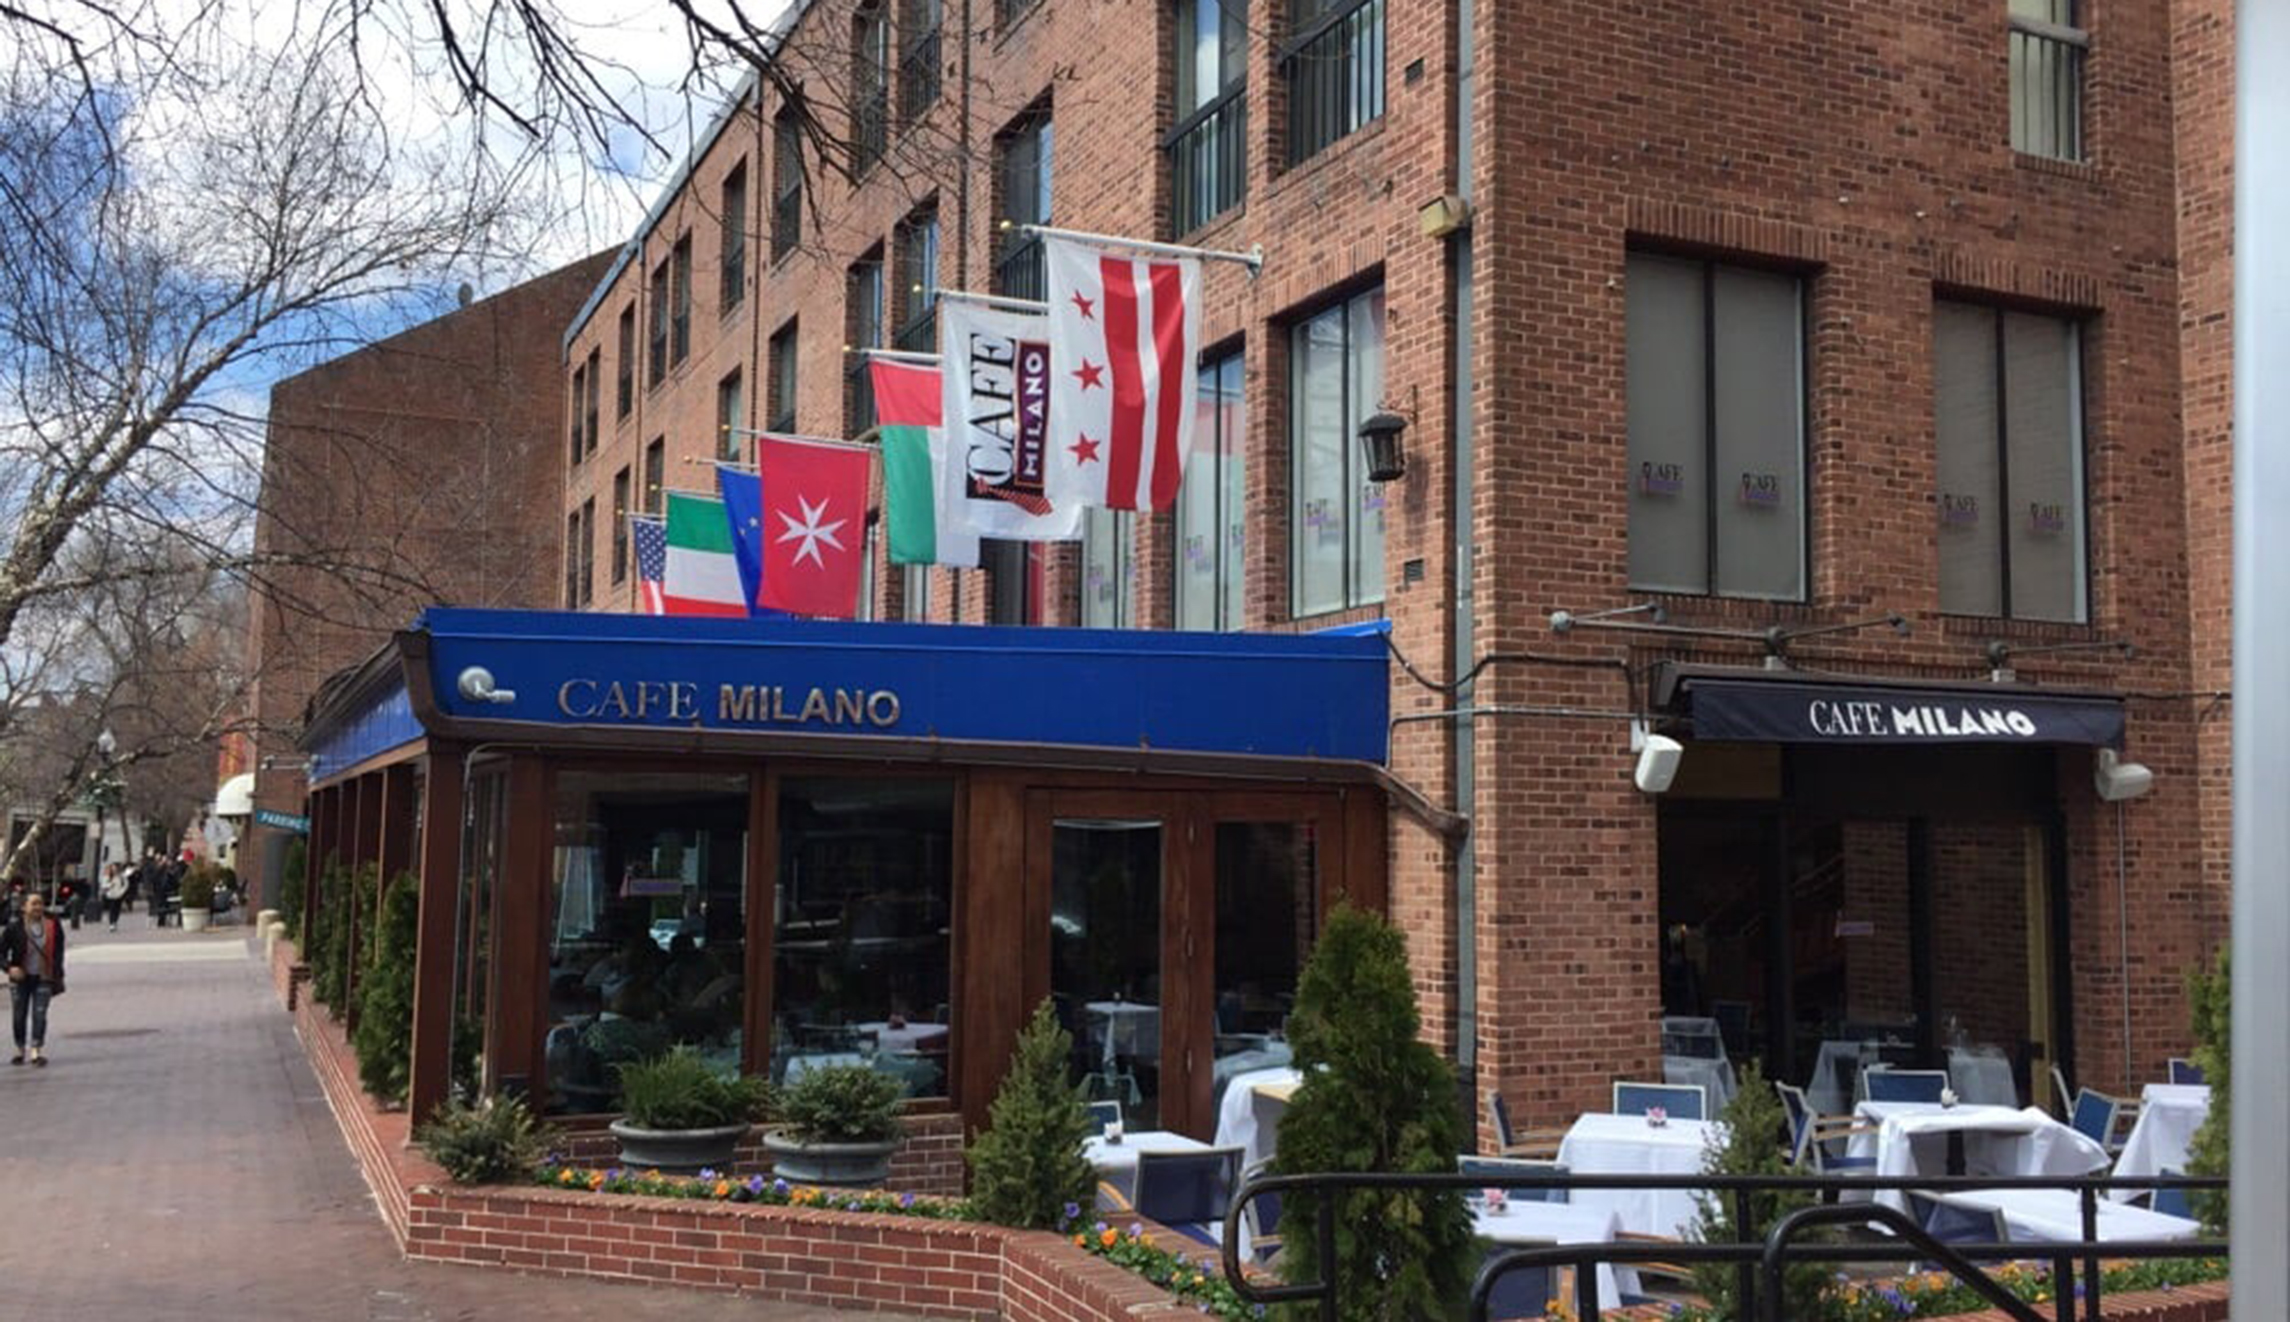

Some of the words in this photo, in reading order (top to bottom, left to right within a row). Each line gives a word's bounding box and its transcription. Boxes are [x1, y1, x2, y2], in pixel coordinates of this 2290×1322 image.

[967, 333, 1016, 487] CAFE
[1023, 351, 1044, 477] MILANO
[557, 679, 699, 718] CAFE
[718, 684, 900, 726] MILANO
[1810, 700, 1888, 735] CAFE
[1891, 706, 2036, 735] MILANO
